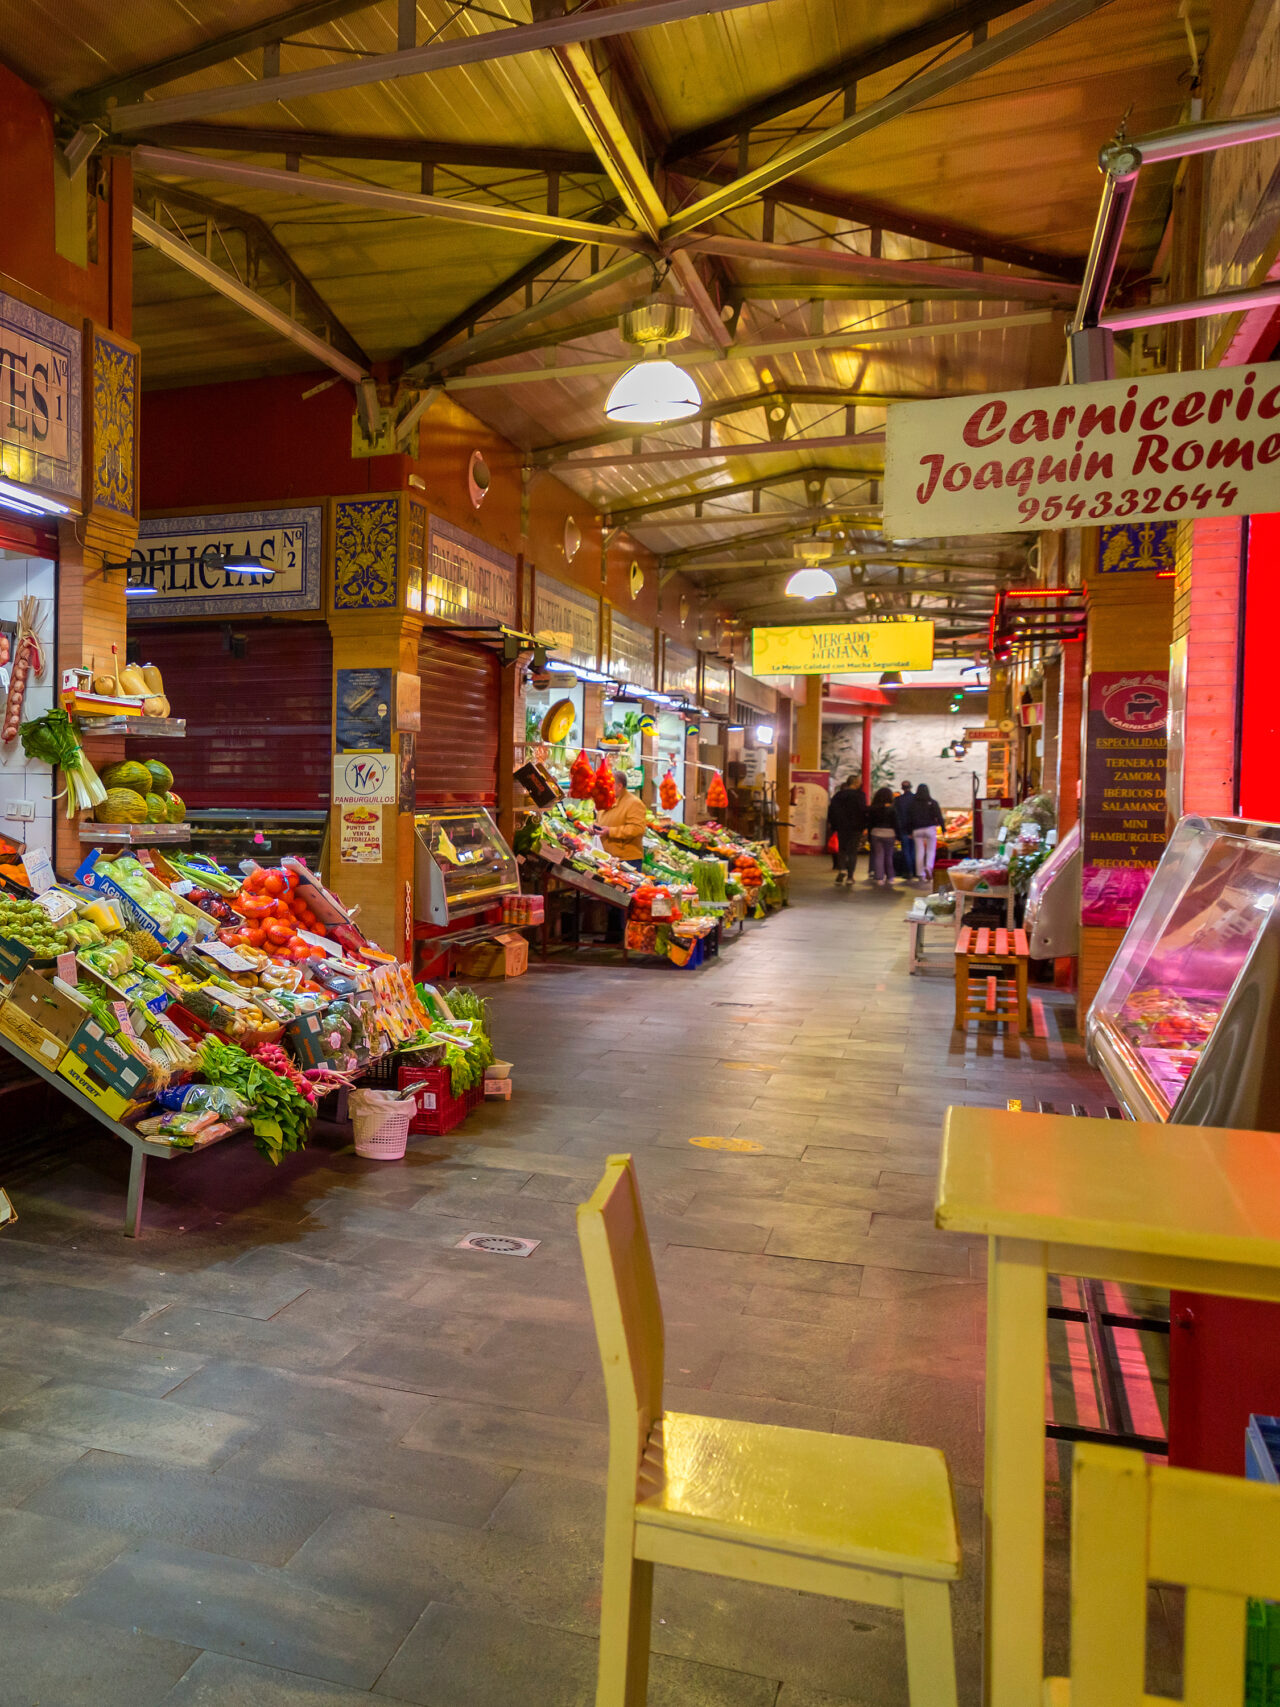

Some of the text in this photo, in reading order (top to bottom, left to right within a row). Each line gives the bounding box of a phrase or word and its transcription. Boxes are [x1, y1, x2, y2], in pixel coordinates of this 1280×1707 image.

[916, 440, 1114, 504] Joaquin
[1018, 481, 1239, 524] 954332644
[287, 551, 296, 568] 2
[813, 632, 870, 649] MERCADO
[819, 643, 869, 659] TRIANA
[873, 660, 910, 669] Seguridad
[1105, 758, 1153, 768] TERNERA
[1114, 772, 1161, 781] ZAMORA
[1123, 819, 1148, 828] MINI
[1130, 846, 1138, 855] Y
